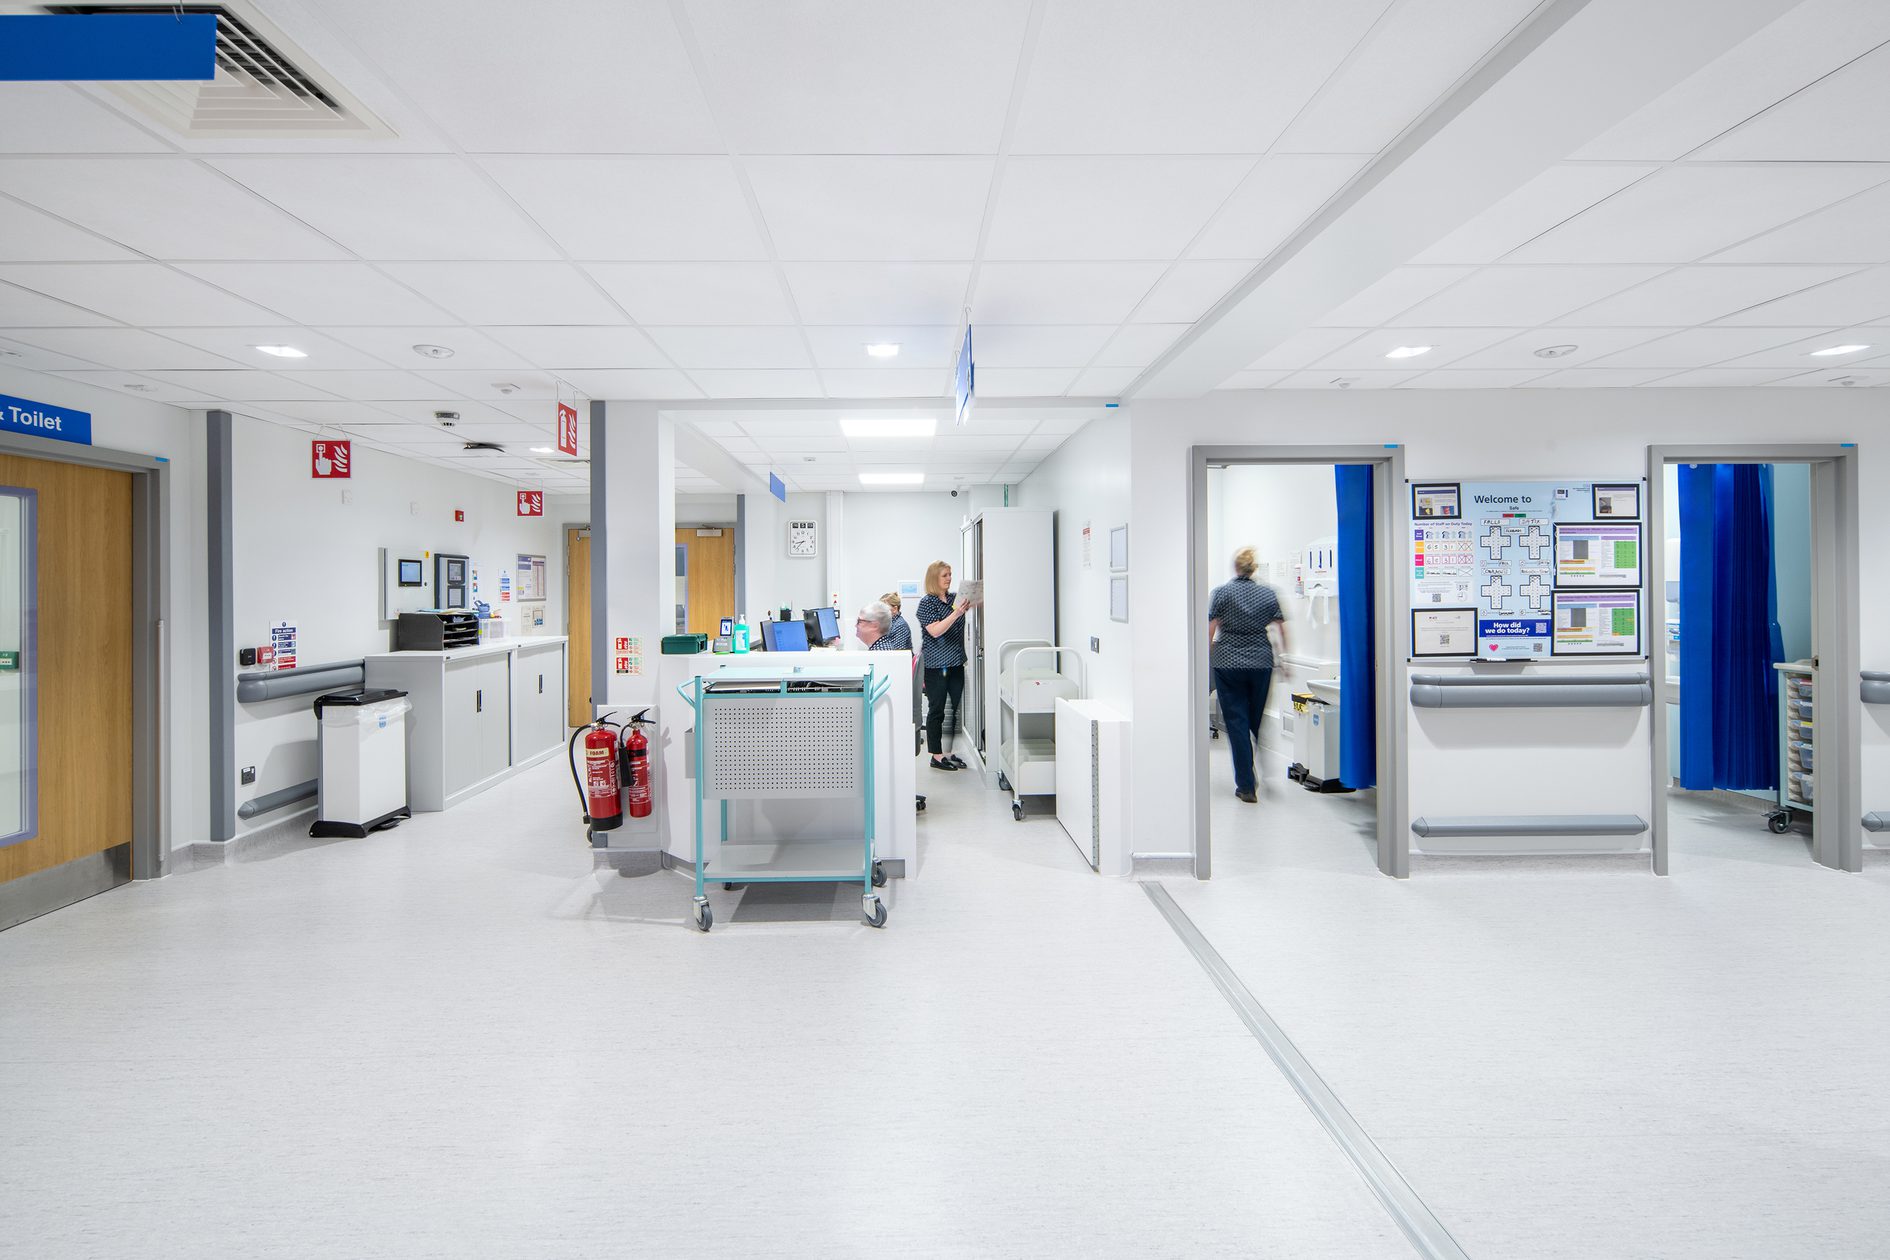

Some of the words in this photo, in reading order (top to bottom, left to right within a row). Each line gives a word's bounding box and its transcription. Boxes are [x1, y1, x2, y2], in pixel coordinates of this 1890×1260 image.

[8, 405, 62, 431] Toilet
[1474, 495, 1519, 503] Welcome
[1521, 495, 1532, 503] to
